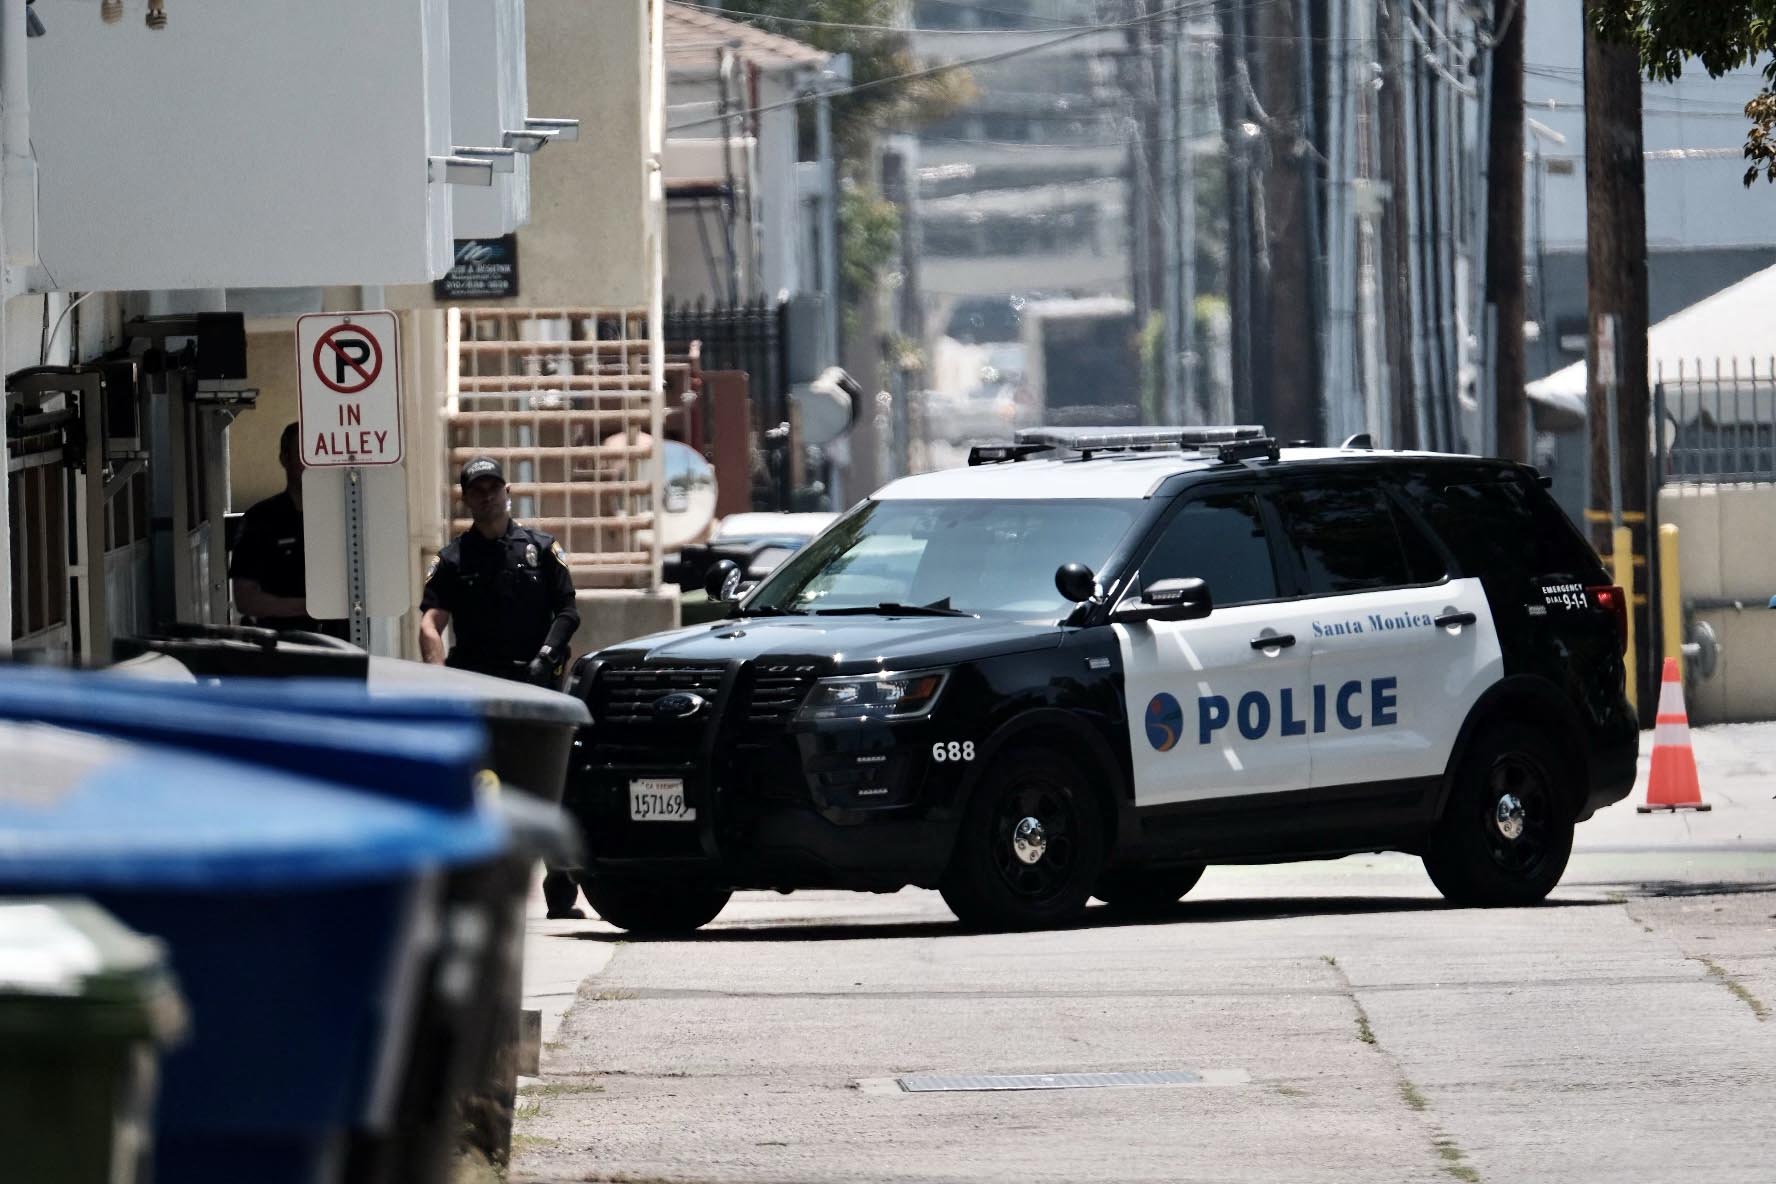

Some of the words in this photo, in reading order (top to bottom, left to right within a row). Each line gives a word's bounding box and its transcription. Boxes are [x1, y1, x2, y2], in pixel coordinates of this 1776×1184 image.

[339, 403, 361, 426] IN
[314, 430, 388, 456] ALLEY
[1541, 583, 1583, 594] EMERGENCY
[1545, 595, 1562, 605] DIAL
[1562, 592, 1588, 610] 9-1-1
[1312, 619, 1363, 638] Santa
[1367, 611, 1432, 632] Monica
[1198, 676, 1398, 745] POLICE
[932, 740, 976, 762] 688
[634, 794, 683, 816] 157169
